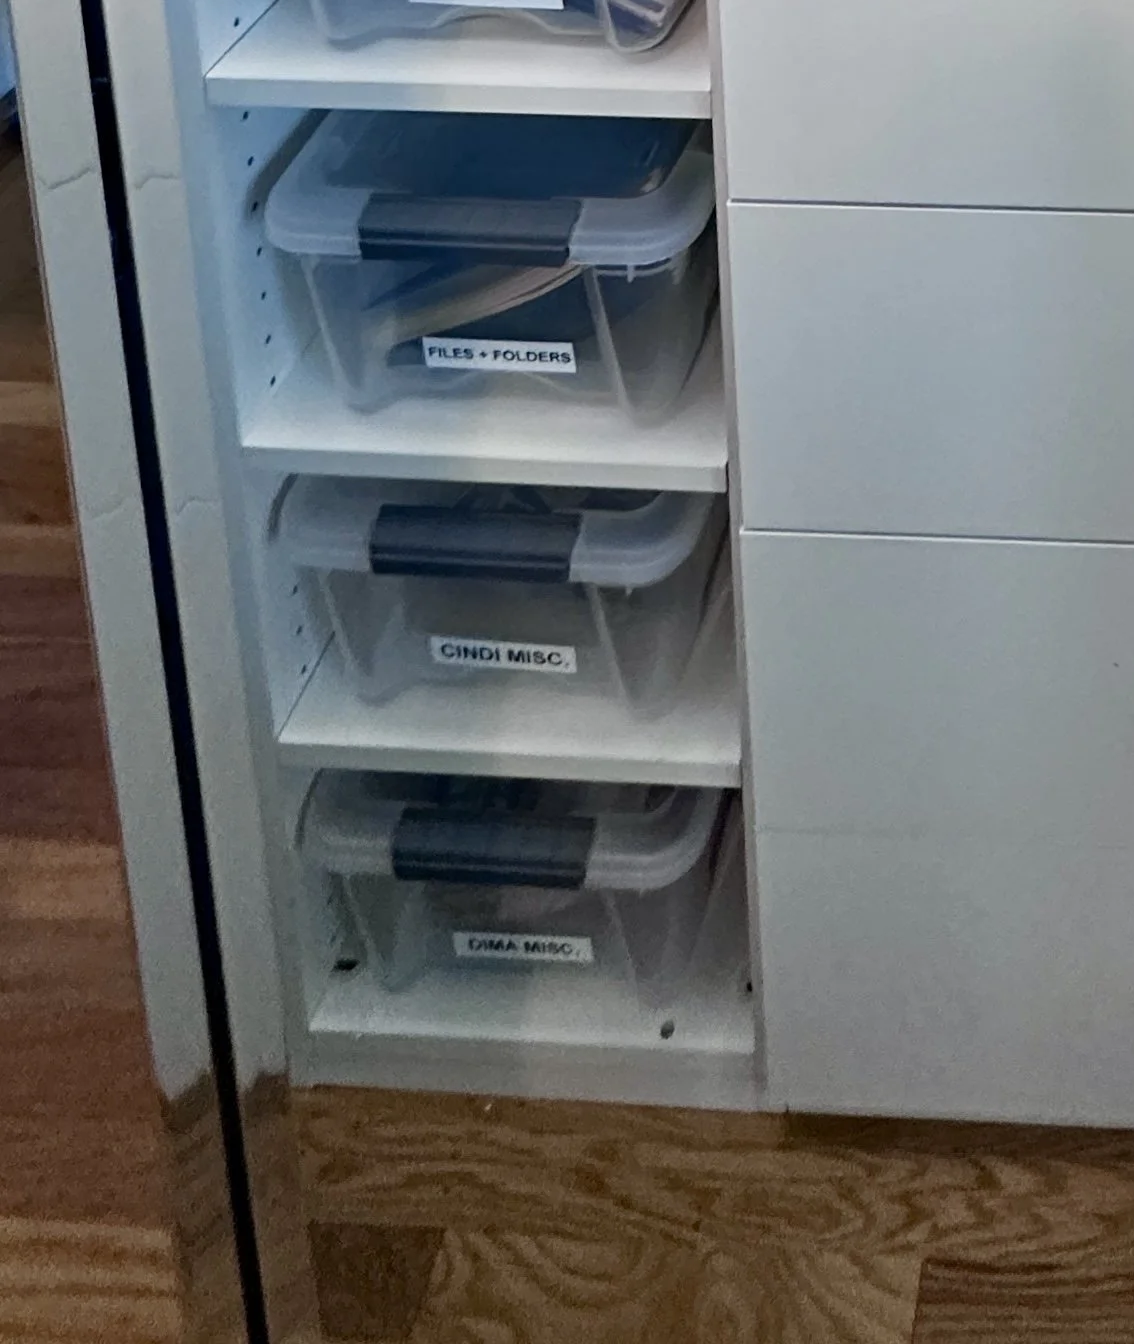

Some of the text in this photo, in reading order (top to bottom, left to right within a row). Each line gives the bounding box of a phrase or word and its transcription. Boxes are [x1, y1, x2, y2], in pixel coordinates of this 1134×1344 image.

[428, 346, 474, 360] FILES
[492, 348, 572, 364] FOLDERS
[440, 643, 500, 662] CINDI
[467, 938, 519, 952] DIMA
